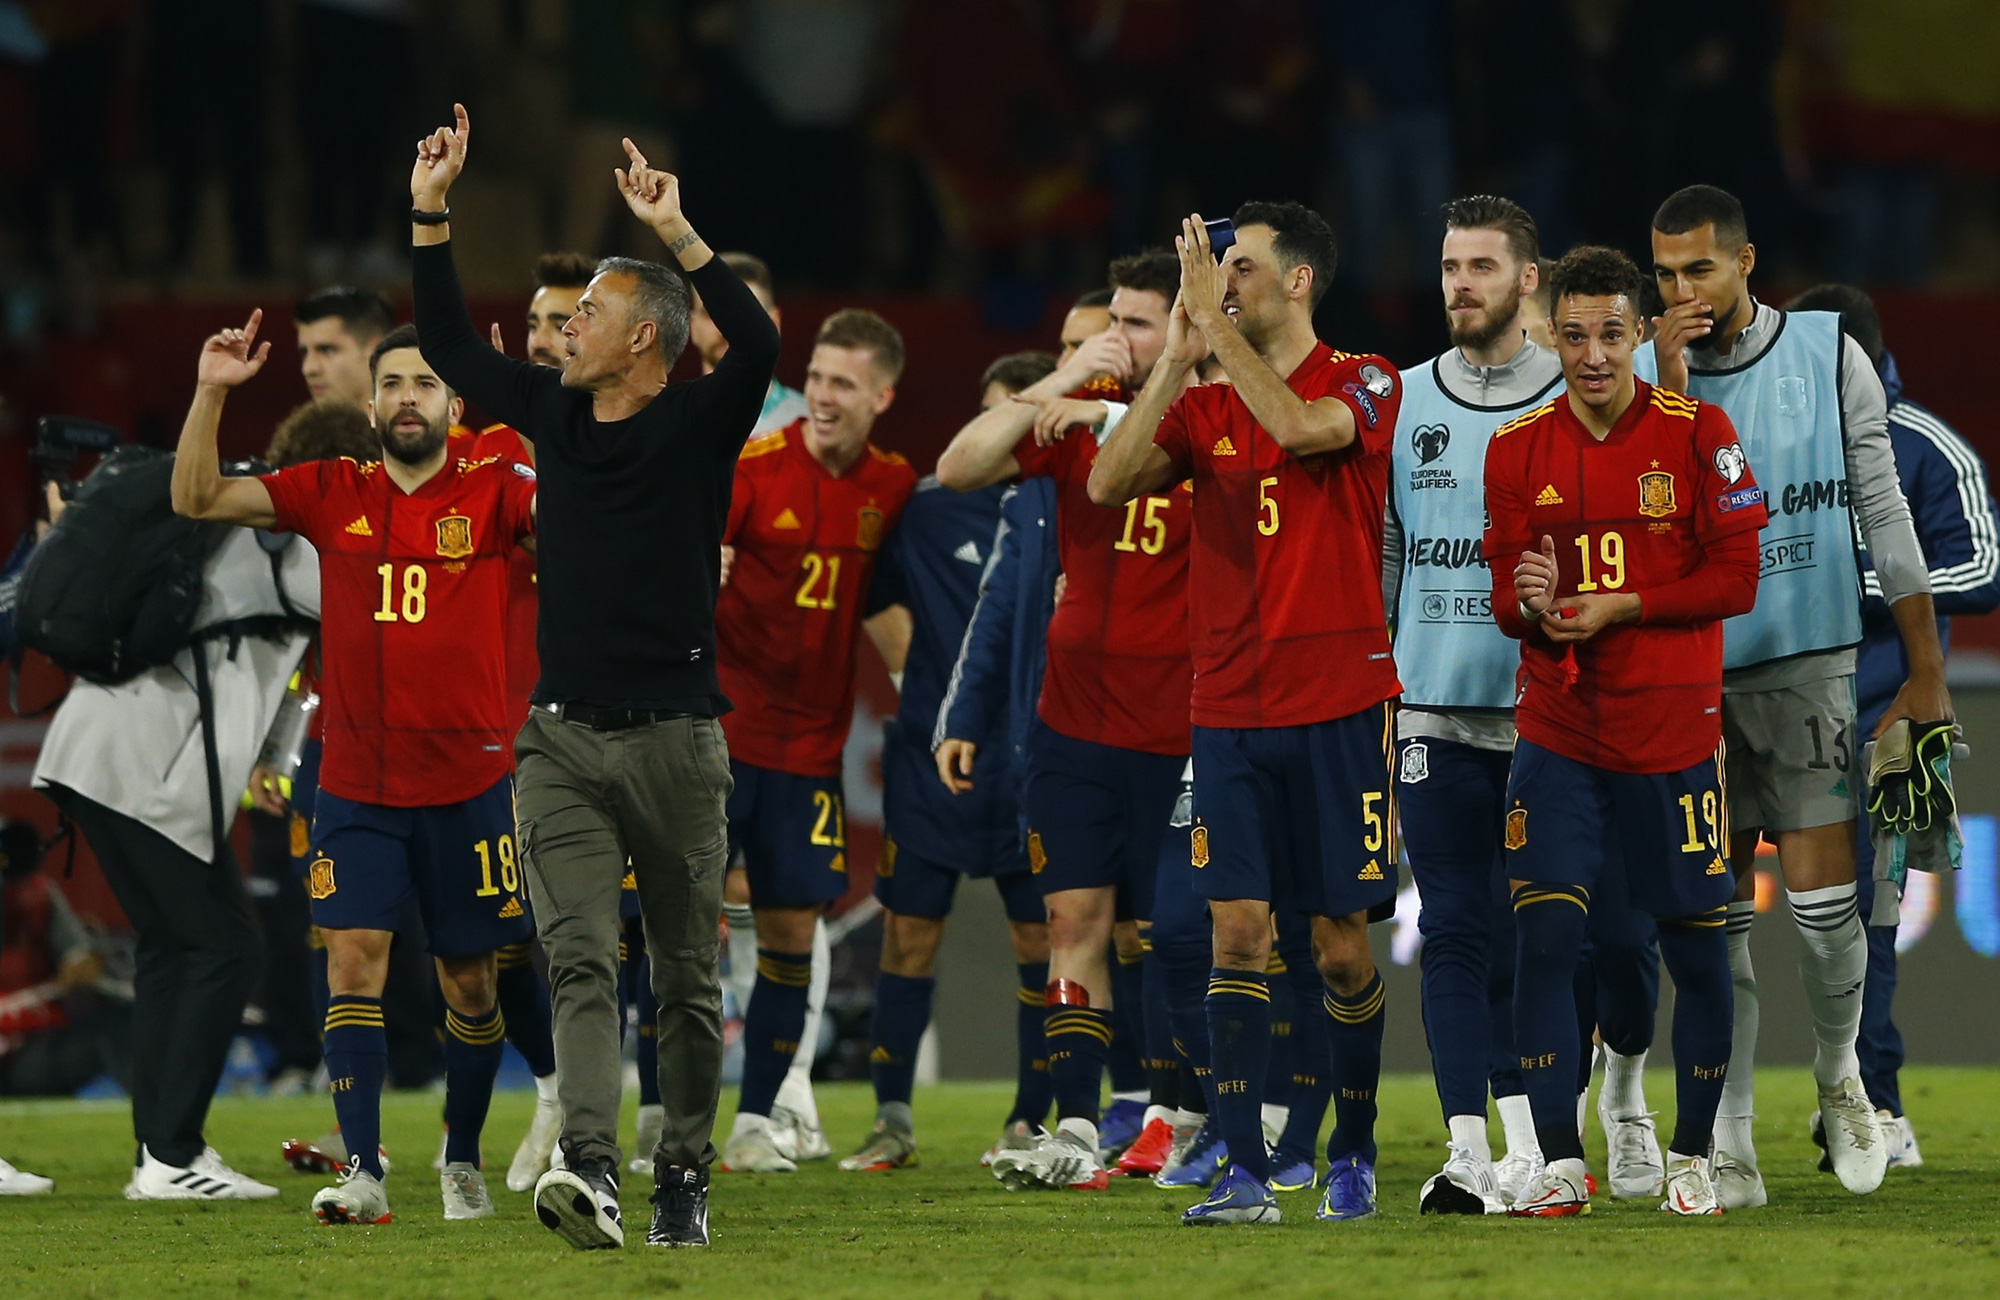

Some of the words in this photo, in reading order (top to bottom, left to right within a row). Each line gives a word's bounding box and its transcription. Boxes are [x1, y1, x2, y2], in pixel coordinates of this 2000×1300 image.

[1355, 390, 1377, 424] RESPECT
[1411, 469, 1452, 480] EUROPEAN
[1535, 497, 1563, 506] adidas
[1731, 490, 1761, 505] RESPECT
[1114, 497, 1171, 556] 15
[1257, 476, 1280, 536] 5
[795, 552, 841, 611] 21
[1408, 531, 1491, 576] #EQUA
[1574, 531, 1626, 592] 19
[373, 563, 428, 624] 18
[1804, 715, 1850, 773] 13
[810, 790, 846, 848] 21
[1362, 791, 1383, 852] 5
[1678, 790, 1718, 853] 19
[473, 833, 519, 897] 18
[1218, 1080, 1248, 1096] RFEF
[1521, 1053, 1557, 1069] RFEF
[1693, 1063, 1728, 1080] RFEF
[1342, 1087, 1371, 1101] RFEF
